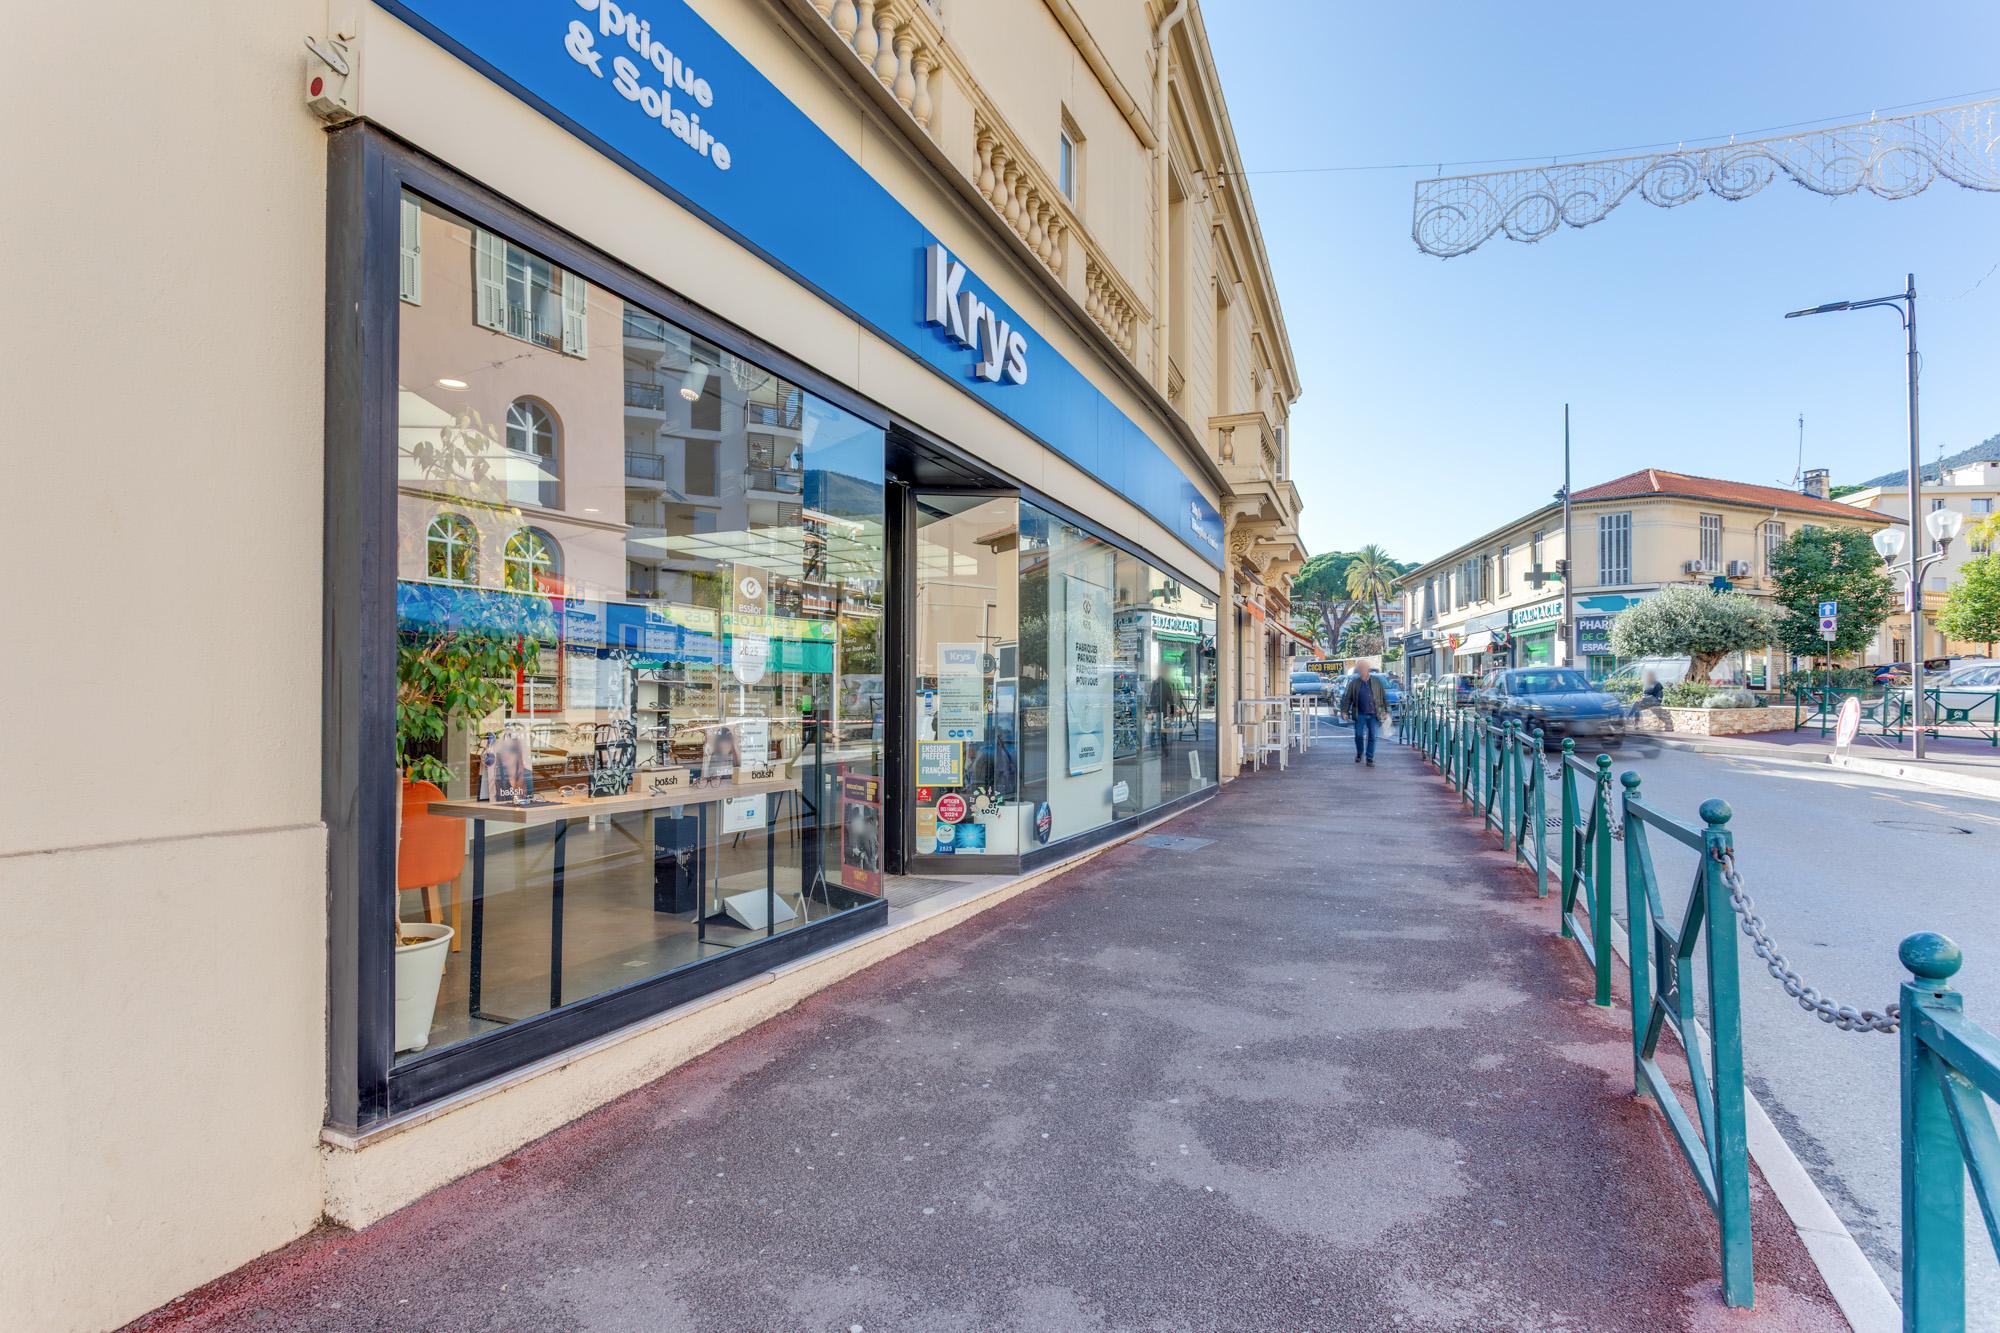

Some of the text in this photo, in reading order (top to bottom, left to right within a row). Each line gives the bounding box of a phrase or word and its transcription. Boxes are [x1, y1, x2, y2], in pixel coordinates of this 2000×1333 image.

[564, 20, 731, 170] & Solaire
[926, 243, 1028, 385] Krys
[738, 603, 762, 615] essilor
[1513, 602, 1563, 625] PHARMACIE
[1582, 633, 1593, 641] DE
[949, 652, 971, 662] Krys
[1308, 662, 1342, 671] COCO FRUITS
[939, 759, 951, 767] DES
[751, 769, 774, 780] ba&sh
[921, 766, 951, 776] FRANÇAIS
[654, 772, 678, 787] ba&sh
[500, 787, 523, 797] ba&sh
